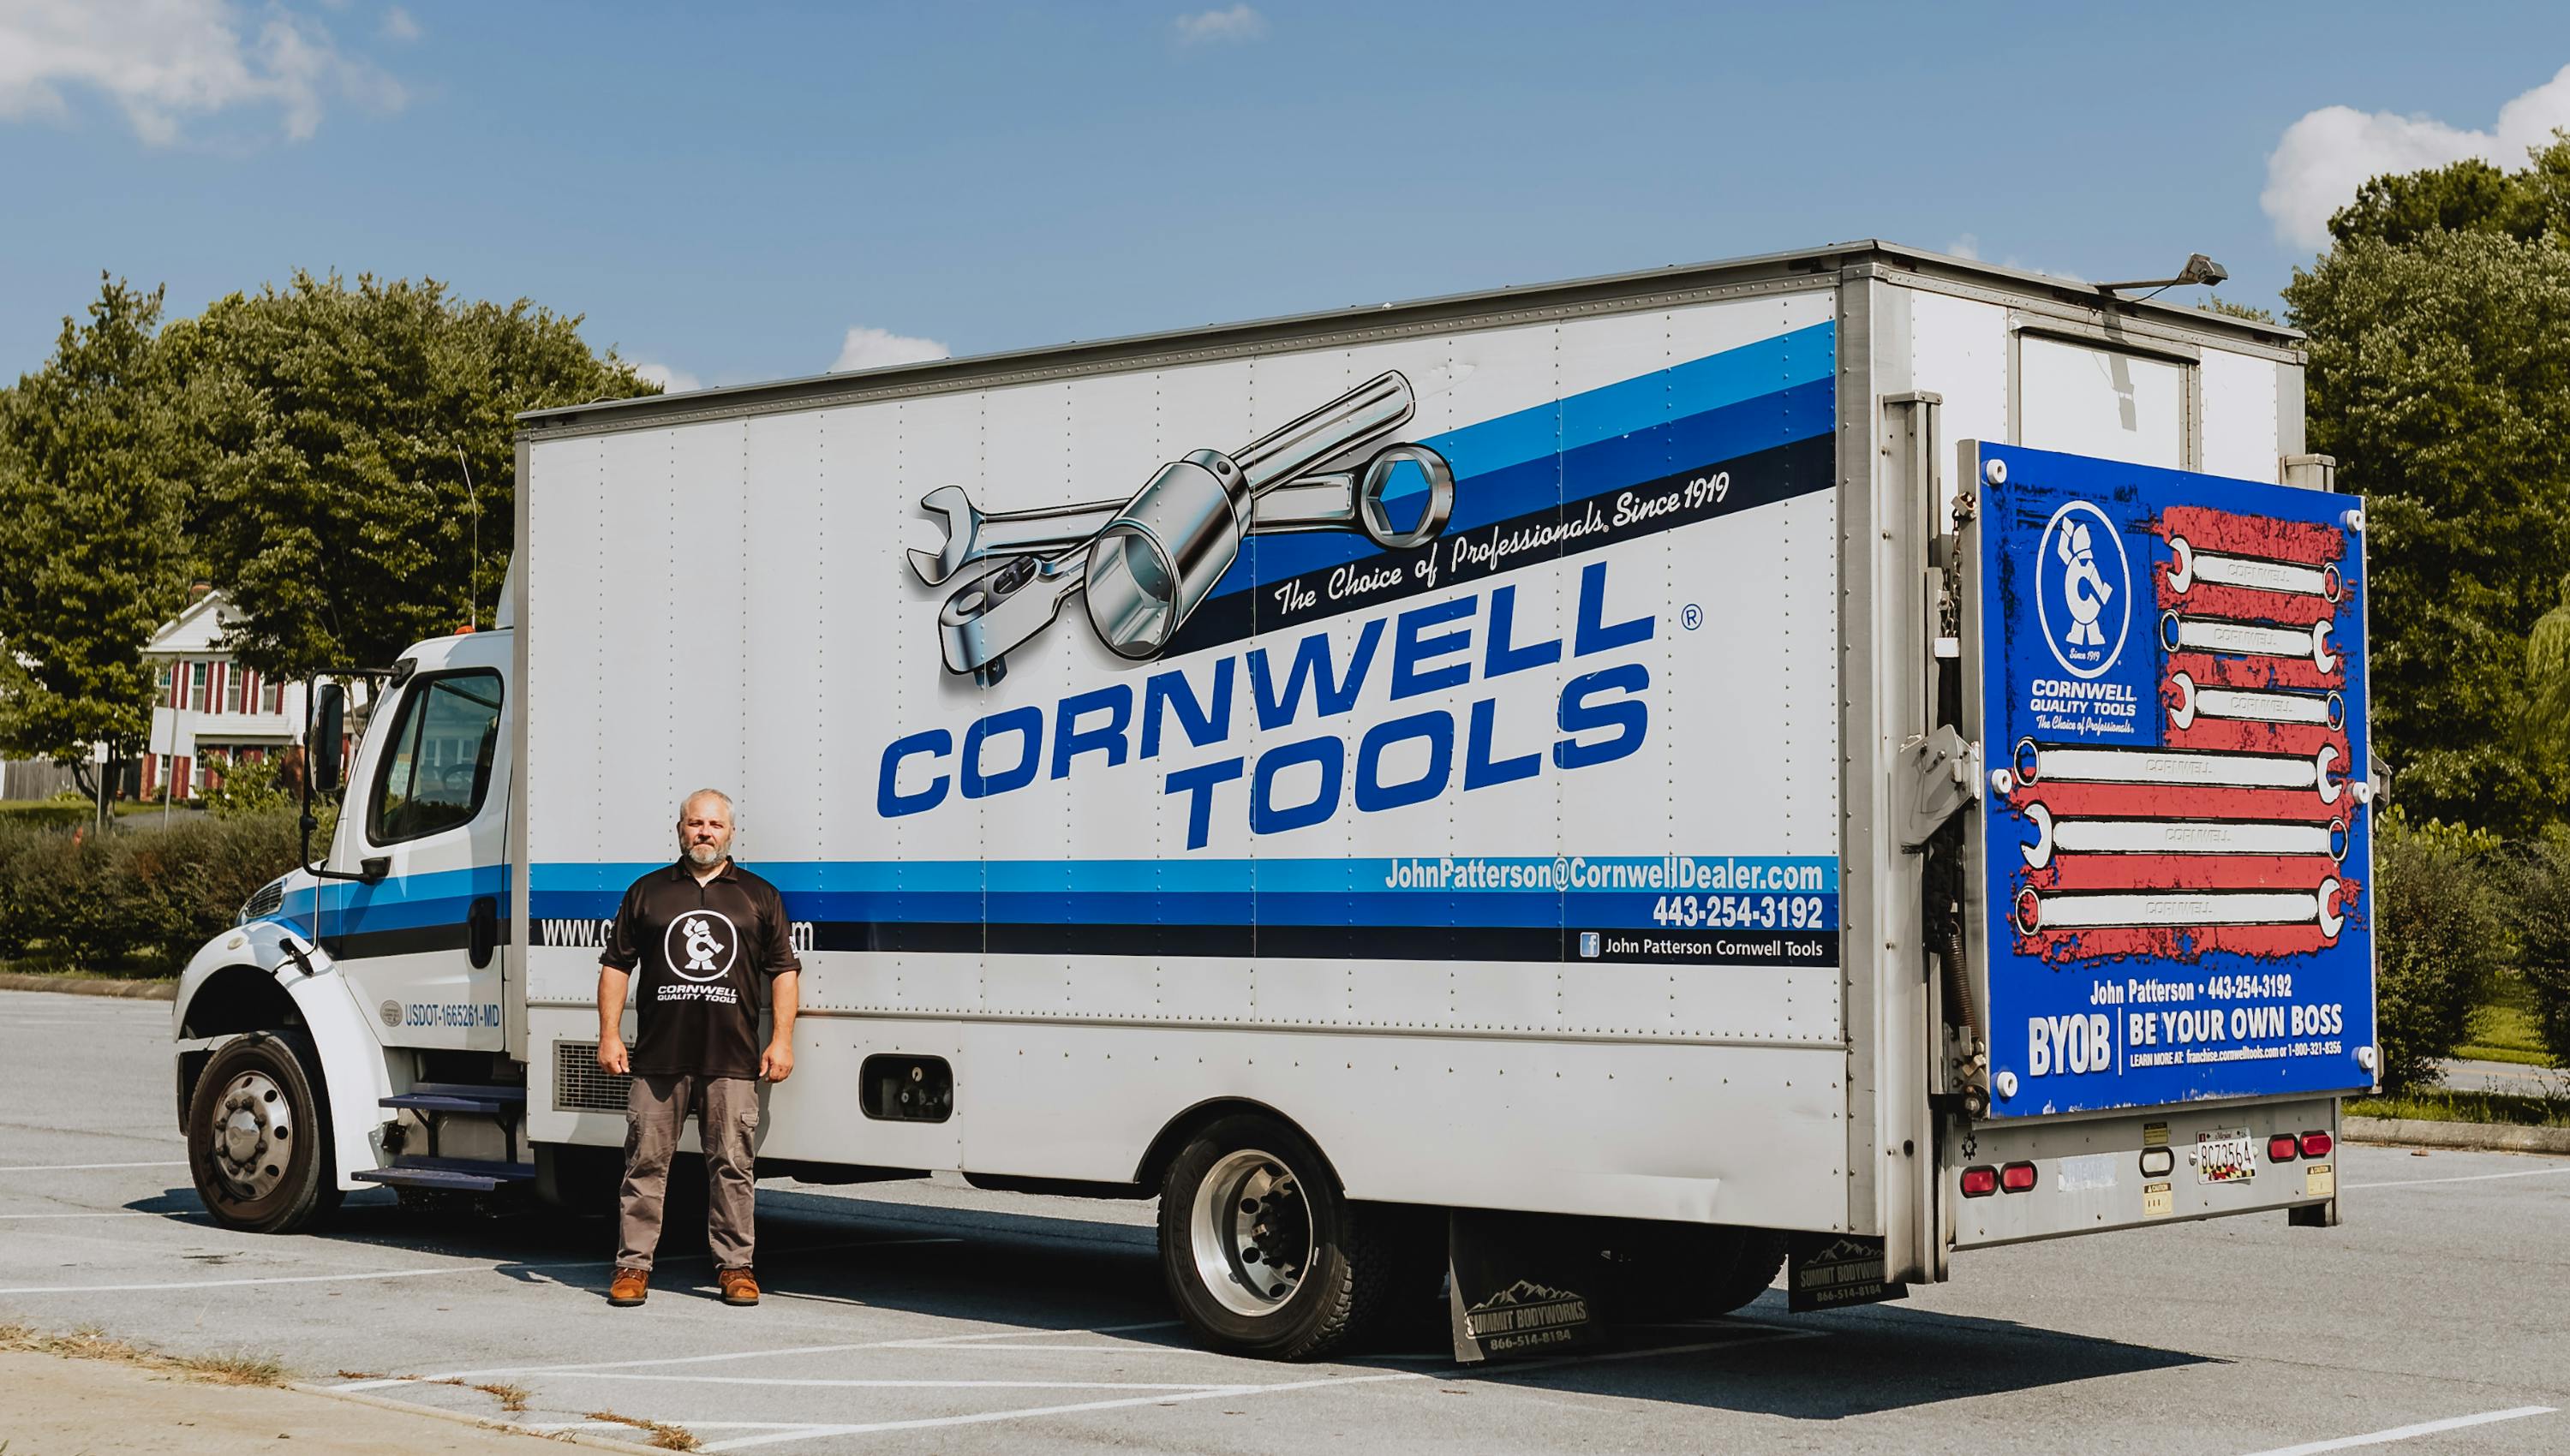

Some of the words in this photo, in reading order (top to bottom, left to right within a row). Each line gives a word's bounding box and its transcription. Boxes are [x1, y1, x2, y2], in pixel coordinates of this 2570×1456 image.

[1274, 580, 1316, 615] The
[1328, 557, 1402, 601] Choice
[1414, 542, 1438, 588] of
[1612, 490, 1680, 528] Since
[1683, 471, 1730, 510] 1919
[2069, 647, 2085, 659] Since
[2087, 650, 2100, 661] 1919
[876, 561, 1655, 820] CORNWELL
[2032, 679, 2133, 701] CORNWELL
[2030, 699, 2088, 713] QUALITY
[2093, 702, 2137, 716] TOOLS
[2036, 714, 2050, 729] The
[2052, 715, 2076, 730] Choice
[2077, 716, 2084, 736] of
[1162, 663, 1651, 851] TOOLS
[1385, 857, 1823, 892] JohnPatterson@CornwellDealer.com
[1653, 896, 1823, 928] 443-254-3192
[1606, 939, 1639, 954] John
[1644, 940, 1712, 955] Patterson
[1716, 940, 1782, 957] Cornwell
[1785, 941, 1823, 957] Tools
[657, 984, 738, 997] CORNWELL
[705, 994, 737, 1004] TOOLS
[2090, 980, 2125, 1005] John
[2128, 978, 2195, 1003] Patterson
[2208, 973, 2292, 1000] 443-254-3192
[405, 1004, 499, 1027] USDOT-1665261-MD
[2130, 1012, 2156, 1046] BE
[2161, 1009, 2226, 1044] YOUR
[2231, 1006, 2285, 1040] OWN
[2291, 1003, 2343, 1036] BOSS
[2130, 1053, 2153, 1067] LEARN
[2154, 1052, 2173, 1066] MORE
[2173, 1051, 2184, 1065] AT:
[2186, 1044, 2279, 1064] franchise.cornwelltools.com
[2280, 1047, 2287, 1058] or
[2288, 1041, 2342, 1057] 1-800-321-8356
[1801, 1267, 1835, 1287] SUMMIT
[1837, 1260, 1884, 1282] BODYWOR
[1817, 1284, 1881, 1302] 866-514-8184
[1467, 1310, 1513, 1335] SUMMIT
[1516, 1301, 1587, 1328] BODYWORKS
[1491, 1329, 1571, 1351] 866-514-8184
